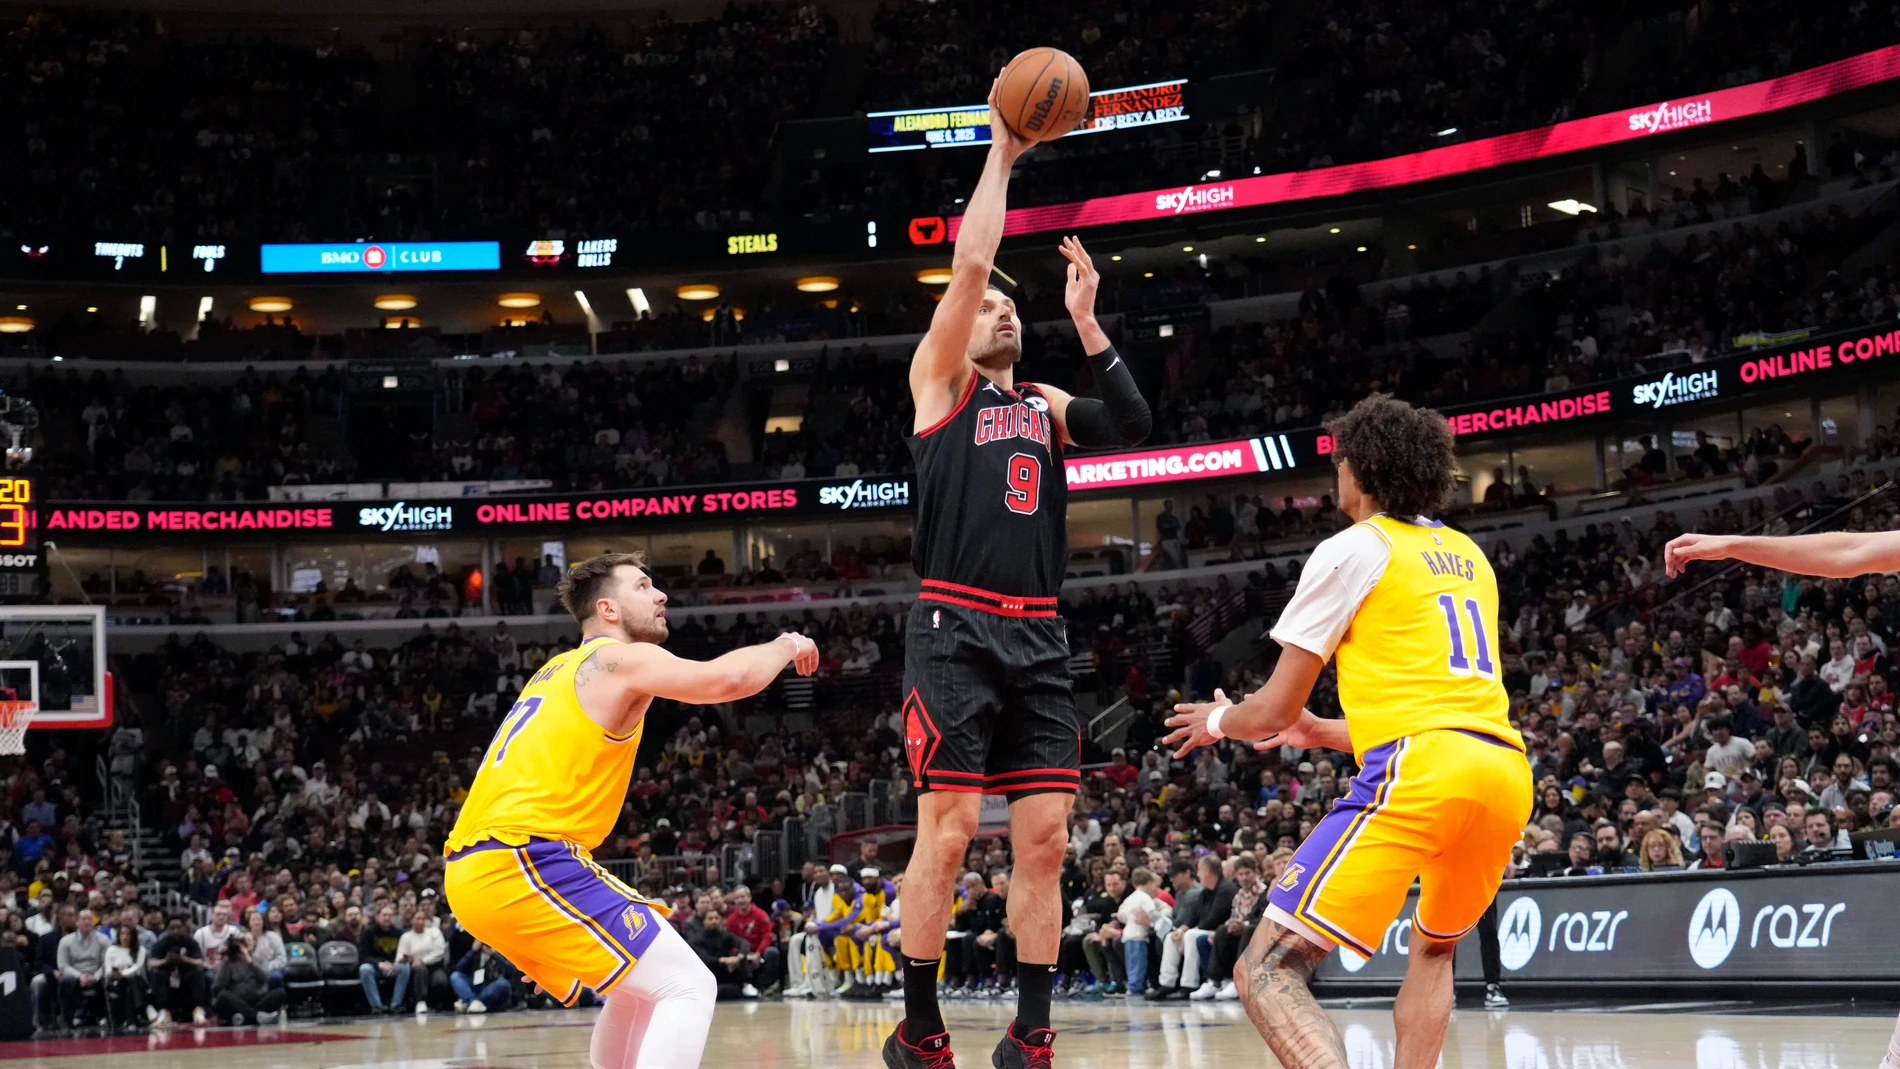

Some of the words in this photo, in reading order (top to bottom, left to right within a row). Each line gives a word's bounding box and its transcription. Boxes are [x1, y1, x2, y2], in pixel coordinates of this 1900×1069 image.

[1025, 77, 1063, 131] Wilson
[1094, 83, 1182, 105] ALEJANDRO
[893, 113, 949, 132] ALEJANDRO
[1095, 116, 1115, 130] DE
[1116, 112, 1145, 128] REY
[1155, 106, 1185, 122] REY
[1628, 100, 1711, 134] SKYHIGH
[1156, 186, 1234, 214] SKYHIGH
[95, 242, 144, 257] TIMEOUTS
[193, 245, 226, 259] FOULS
[321, 251, 360, 264] BMO
[400, 250, 442, 263] CLUB
[577, 239, 617, 254] LAKERS
[728, 233, 778, 255] STEALS
[578, 253, 611, 267] BULLS
[1740, 346, 1832, 384] ONLINE
[1633, 369, 1718, 409] SKYHIGH
[1664, 389, 1718, 407] MARKETING
[819, 479, 909, 510] SKYHIGH
[1005, 452, 1042, 515] 9
[148, 508, 332, 530] MERCHANDISE
[359, 501, 452, 531] SKYHIGH
[476, 503, 570, 524] ONLINE
[576, 495, 697, 521] COMPANY
[702, 489, 798, 513] STORES
[0, 554, 37, 567] SOT
[1421, 551, 1475, 582] HAYES
[1437, 593, 1495, 681] 11
[1548, 909, 1628, 952] razr
[1750, 902, 1846, 949] razr
